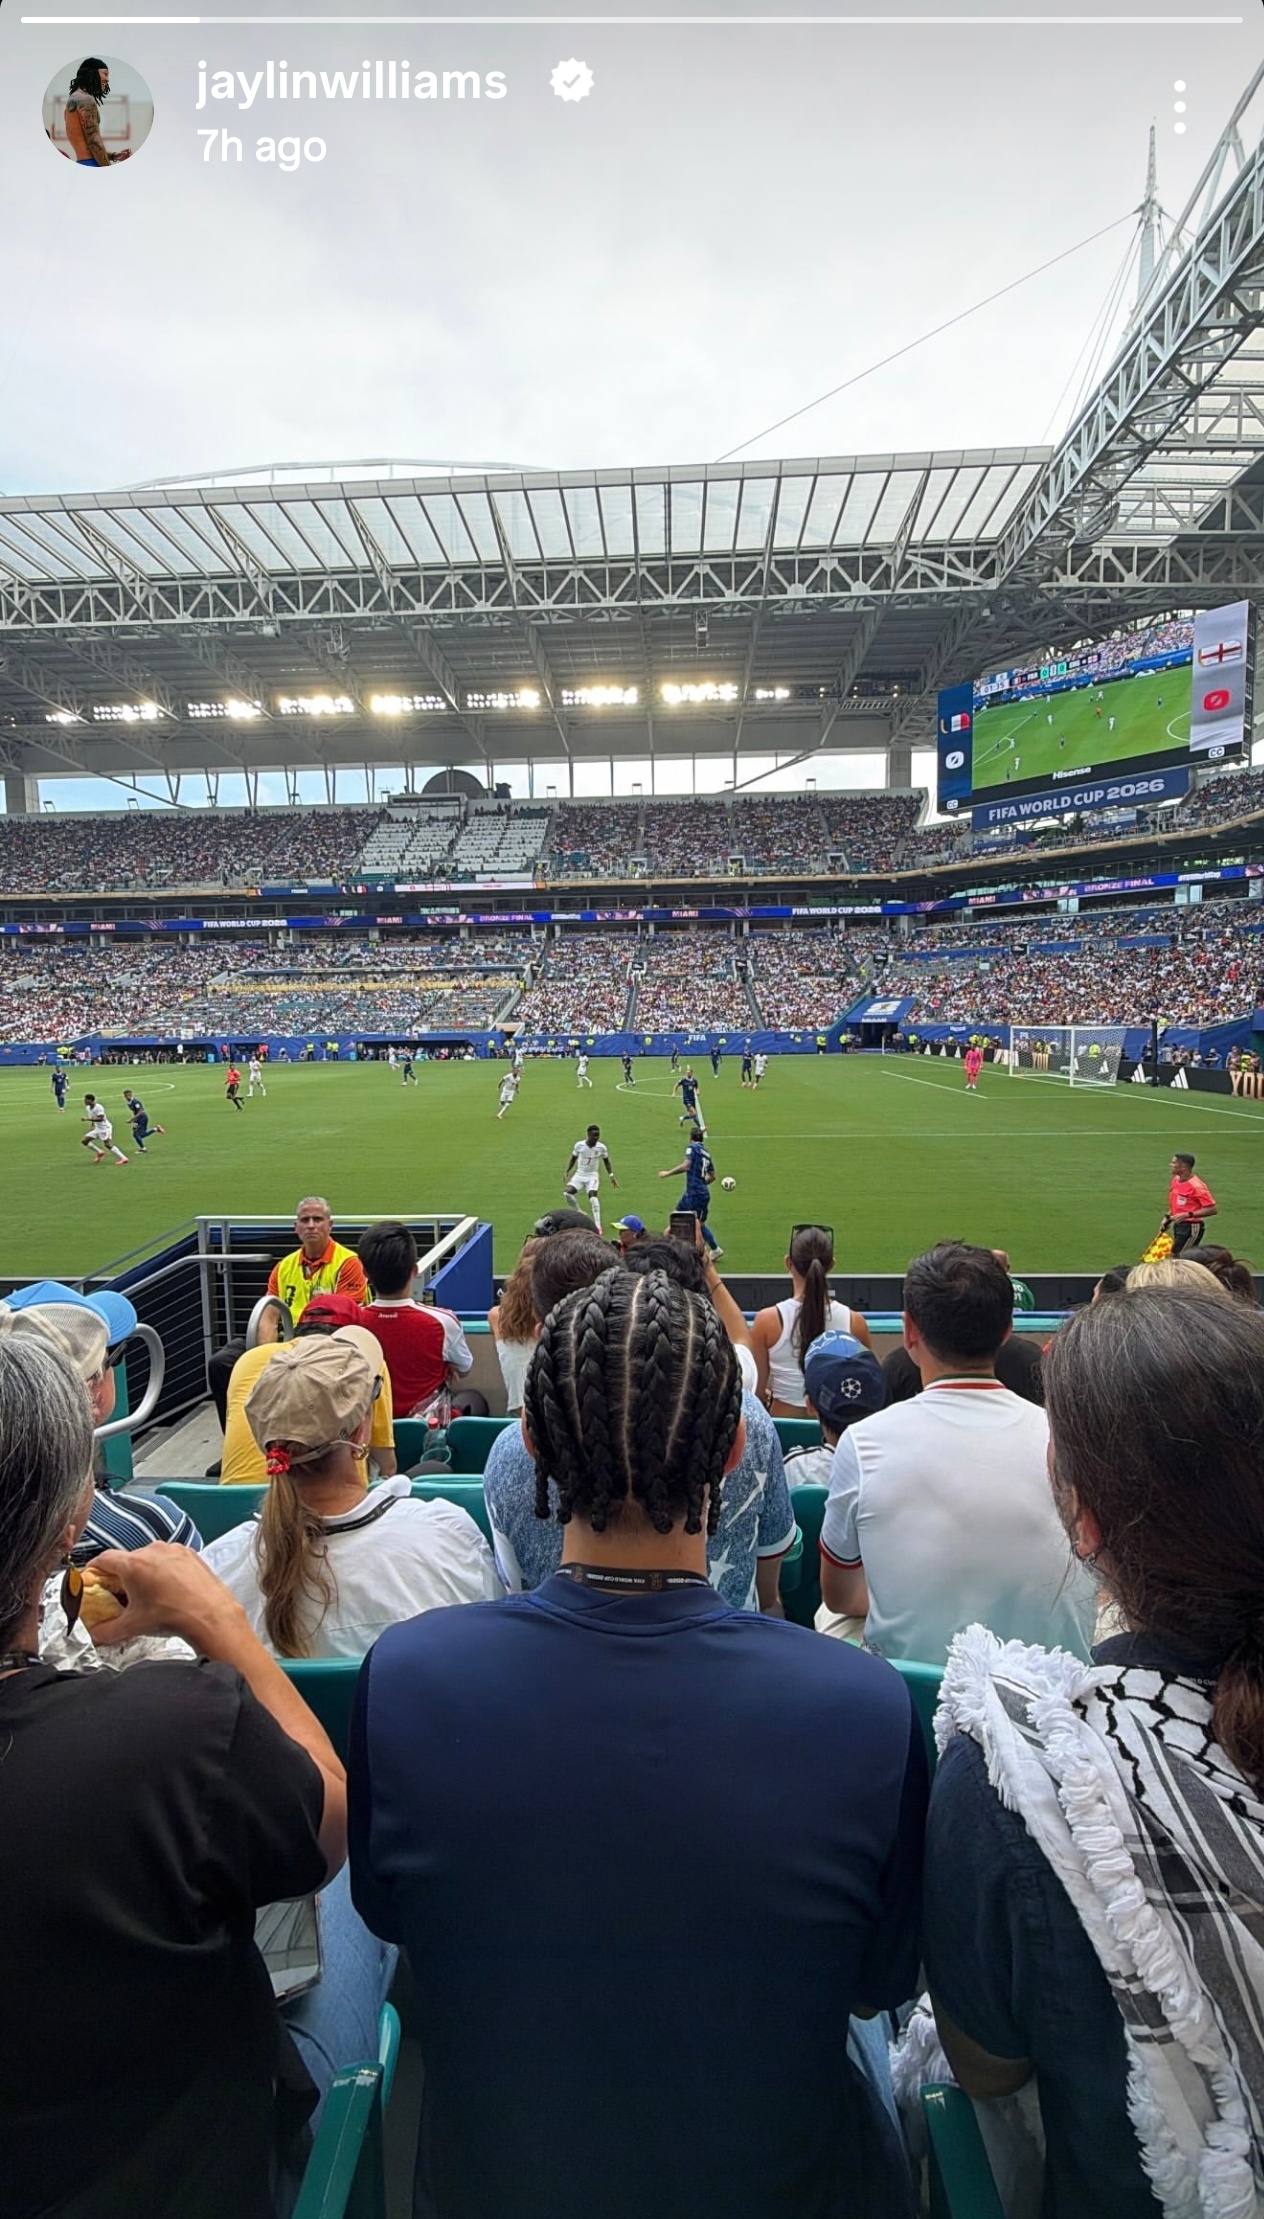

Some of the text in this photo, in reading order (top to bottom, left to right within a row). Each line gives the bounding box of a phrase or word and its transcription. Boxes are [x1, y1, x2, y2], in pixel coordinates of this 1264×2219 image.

[985, 682, 1005, 692] 01:35
[1053, 767, 1092, 780] Hisense
[989, 779, 1165, 821] FIFA WORLD CUP 2026
[1085, 879, 1155, 892] BRONZE FINAL
[968, 896, 997, 905] MIAMI
[809, 907, 837, 915] WORLD
[220, 920, 246, 928] WORLD
